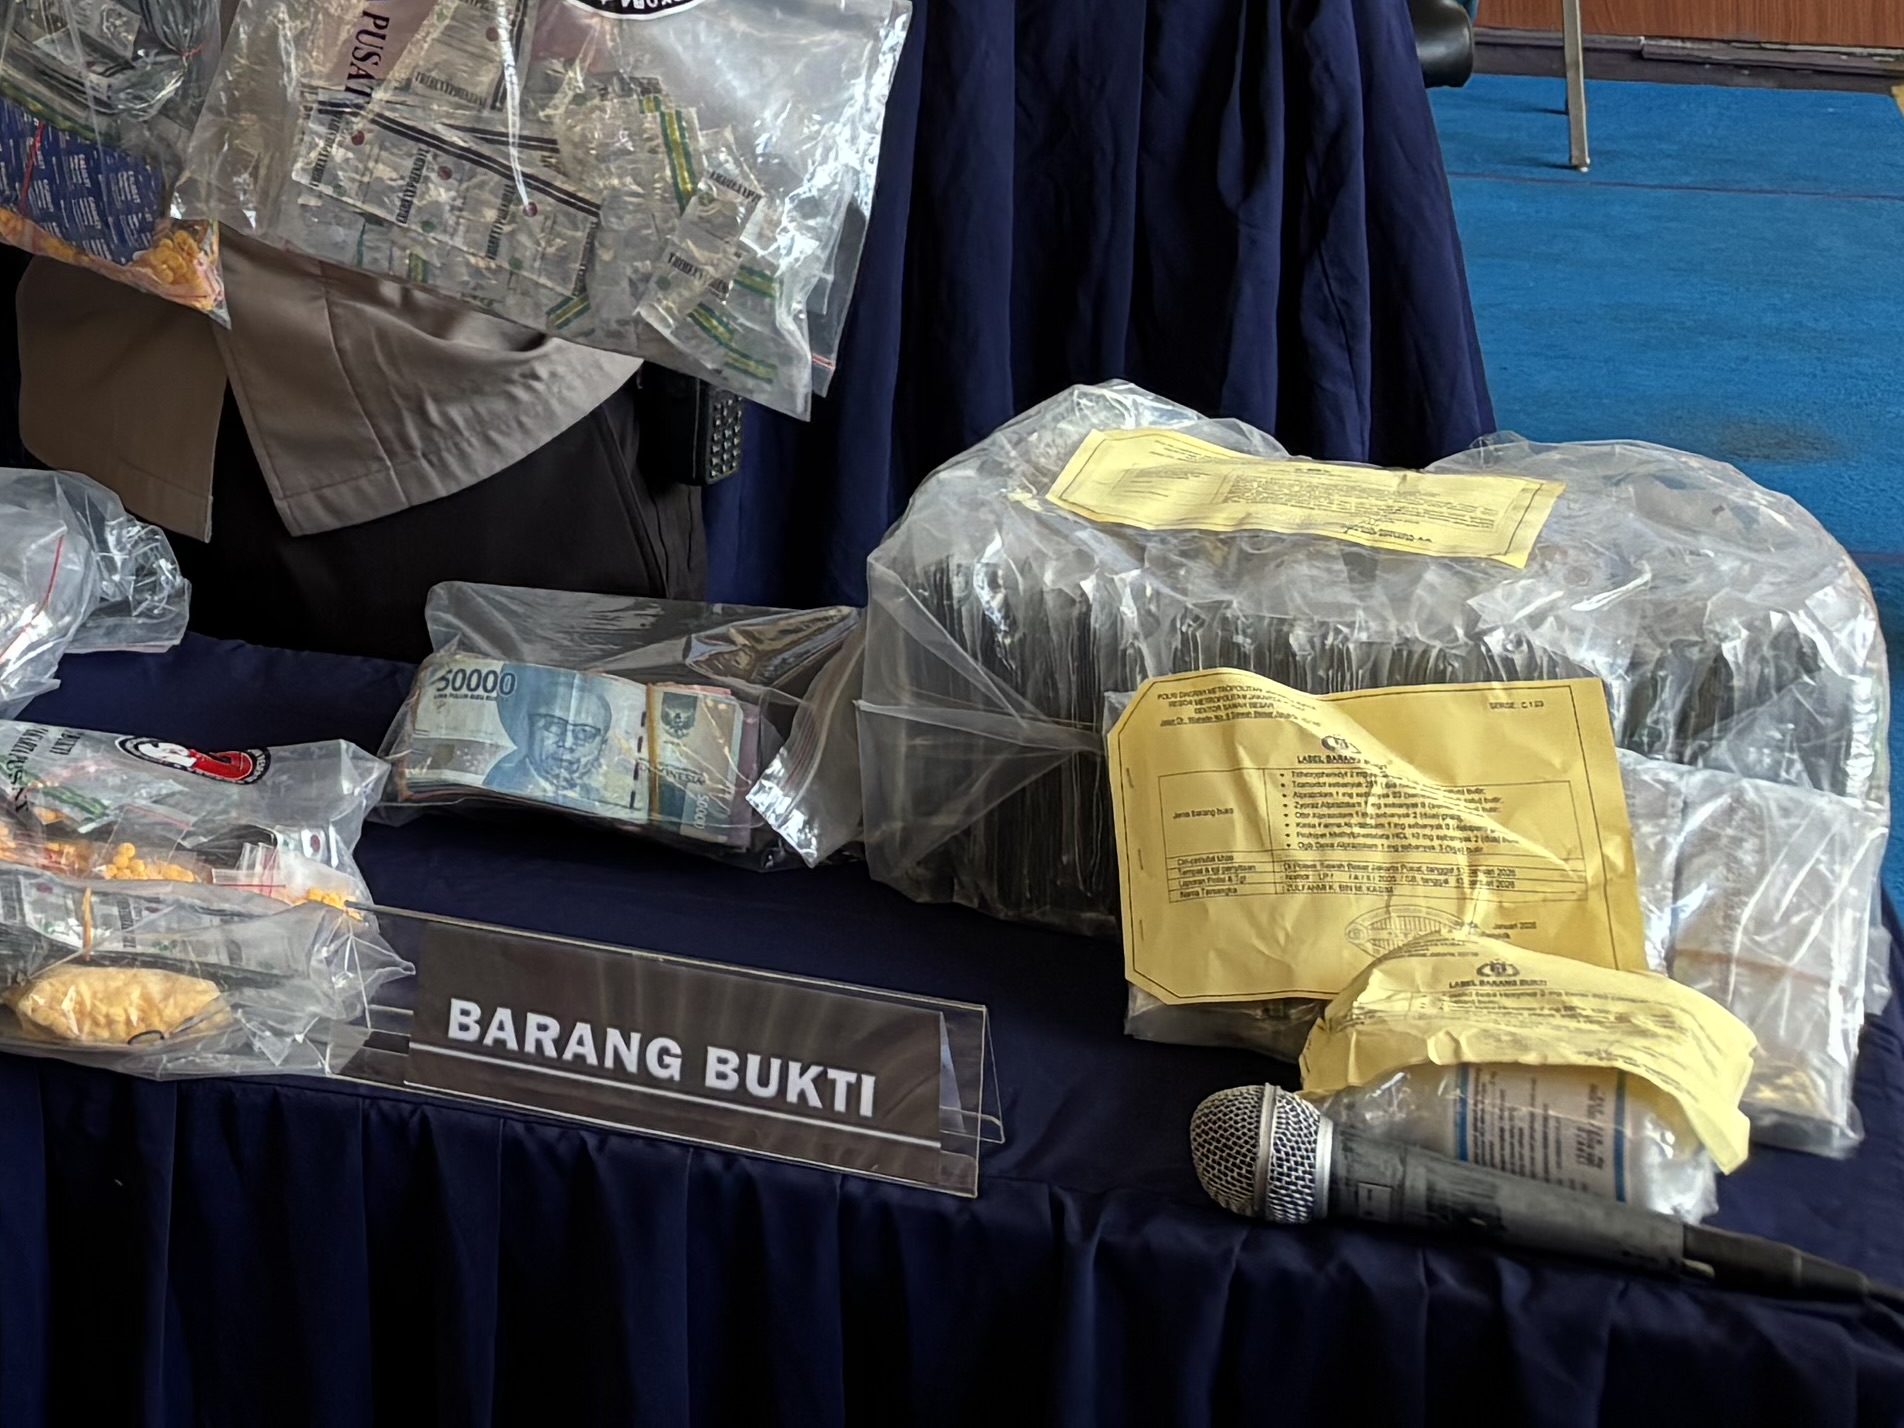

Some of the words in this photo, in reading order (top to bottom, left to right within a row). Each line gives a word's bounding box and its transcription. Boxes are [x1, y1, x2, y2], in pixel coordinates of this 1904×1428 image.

[344, 9, 390, 99] PUSAT
[436, 667, 517, 696] 50000
[447, 998, 682, 1082] BARANG
[704, 1046, 877, 1117] BUKTI
